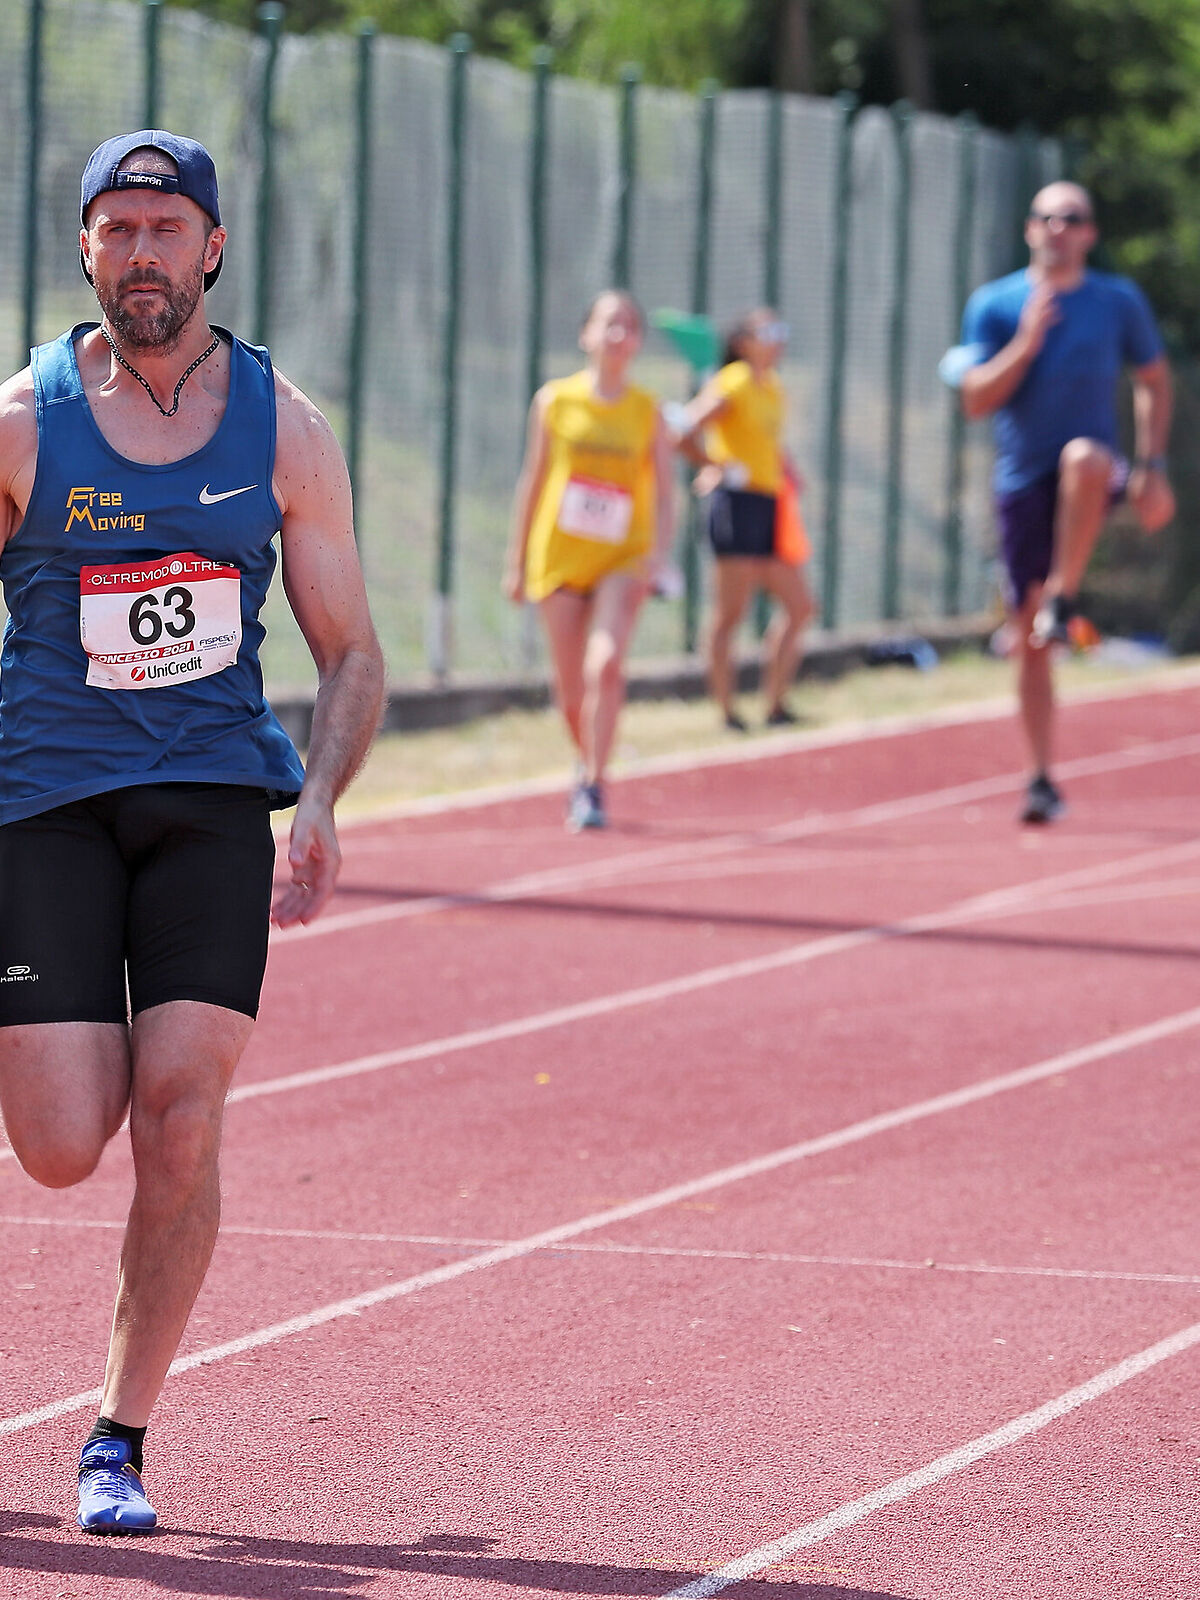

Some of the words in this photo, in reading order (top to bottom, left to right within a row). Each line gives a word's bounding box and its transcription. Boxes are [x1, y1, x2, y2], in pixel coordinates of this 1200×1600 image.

[126, 175, 162, 186] macron
[66, 487, 122, 508] Free
[64, 506, 145, 532] Moving
[129, 586, 195, 646] 63
[162, 641, 192, 657] 2021
[147, 656, 202, 679] UniCredit
